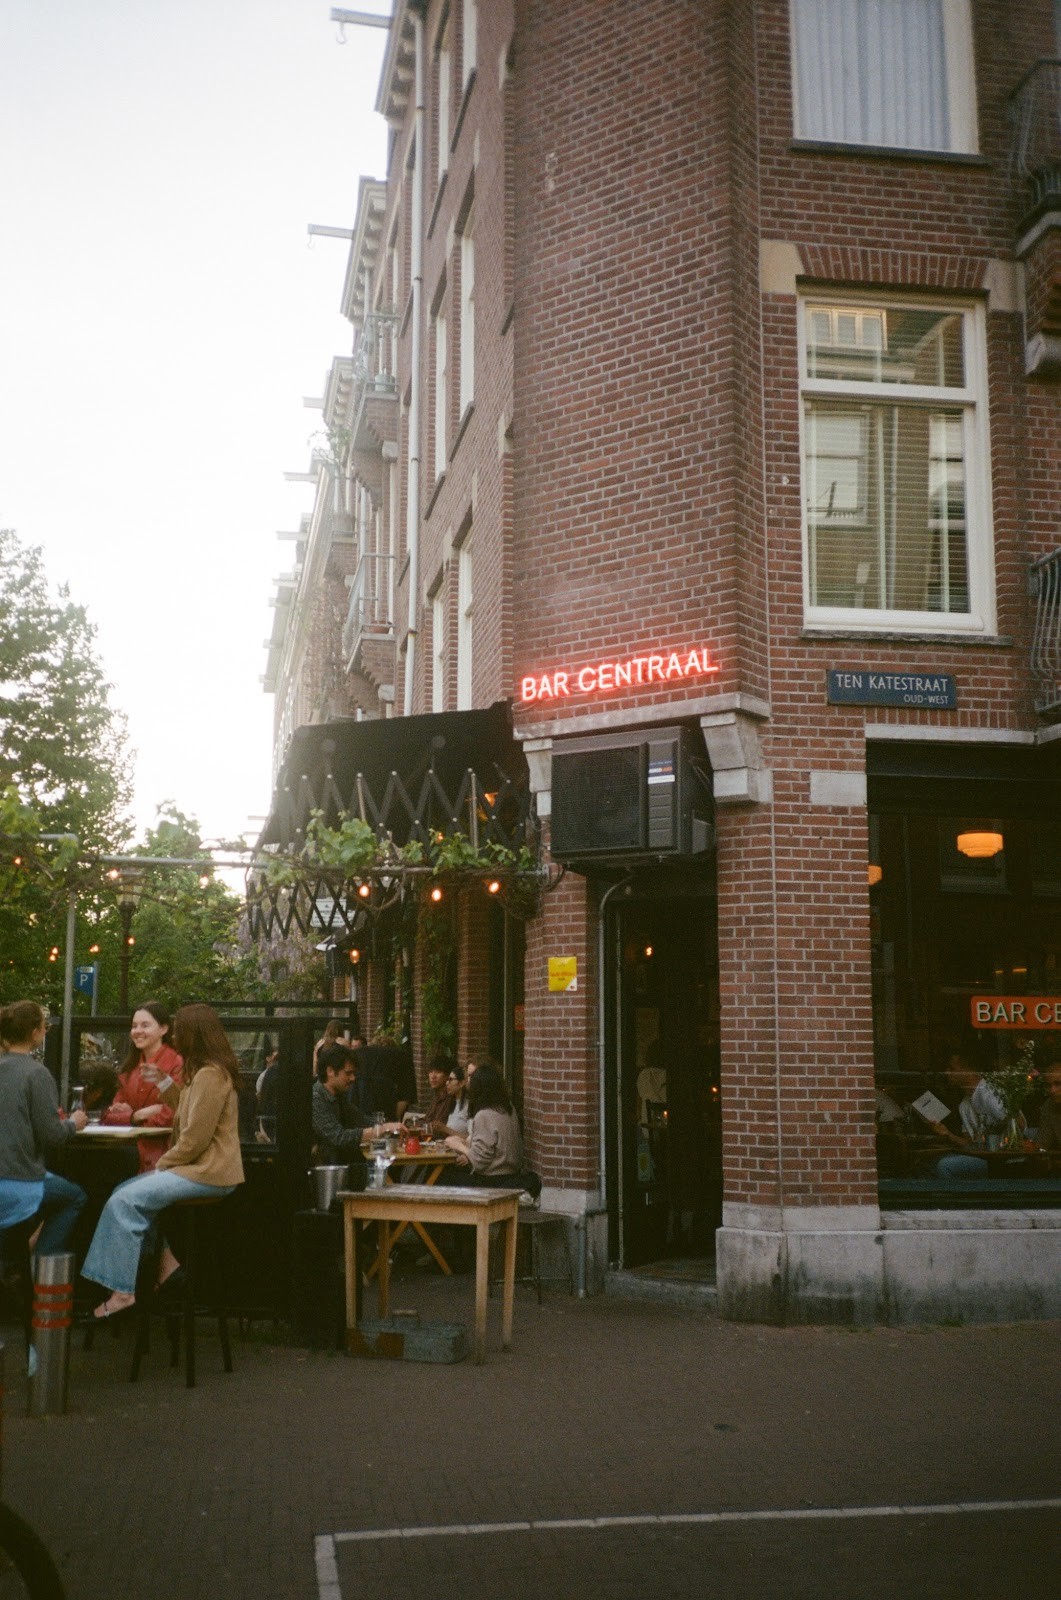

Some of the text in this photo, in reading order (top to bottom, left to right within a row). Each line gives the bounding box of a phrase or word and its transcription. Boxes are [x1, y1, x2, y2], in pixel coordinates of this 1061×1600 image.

[521, 648, 719, 701] BAR CENTRAAL
[836, 673, 948, 692] TEN KATESTRAAT
[80, 973, 88, 986] P
[976, 1001, 1026, 1022] BAR
